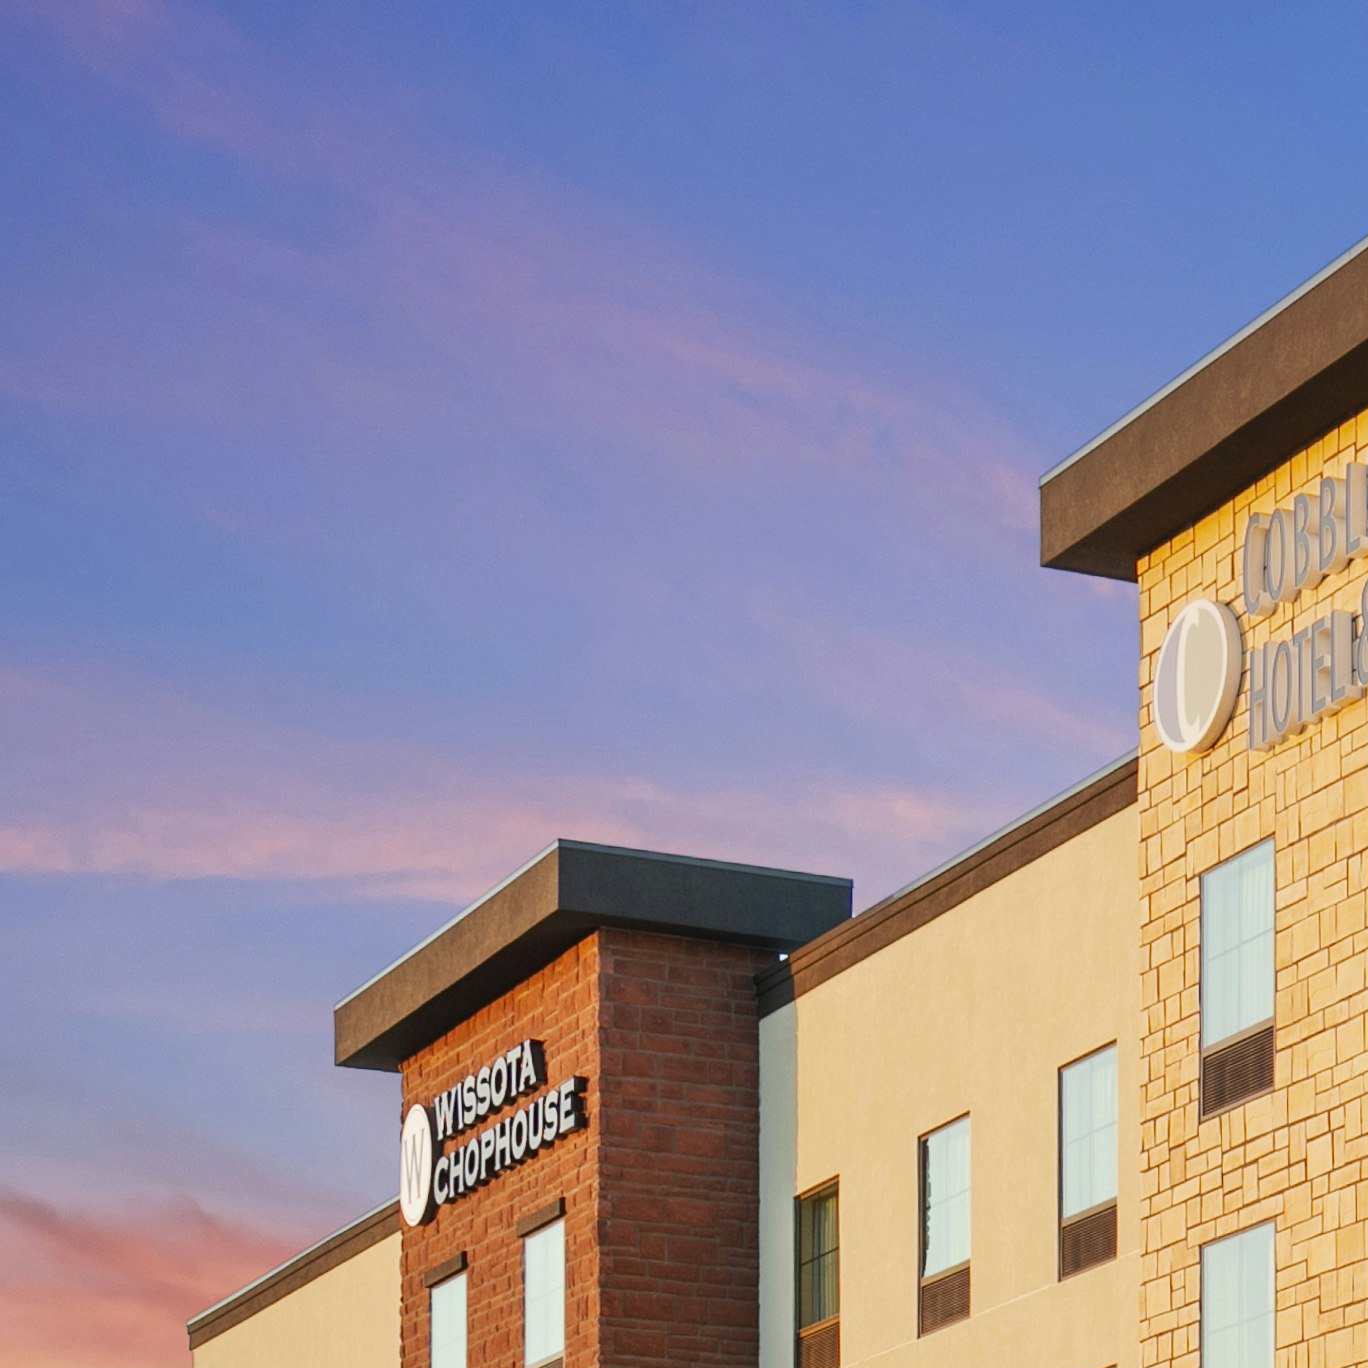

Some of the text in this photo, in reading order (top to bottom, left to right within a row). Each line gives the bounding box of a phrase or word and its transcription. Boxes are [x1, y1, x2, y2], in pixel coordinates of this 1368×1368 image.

[1249, 609, 1362, 750] HOTEL
[433, 1076, 577, 1205] CHOPHOUSE
[434, 1039, 538, 1141] WISSOTA
[404, 1128, 424, 1205] W
